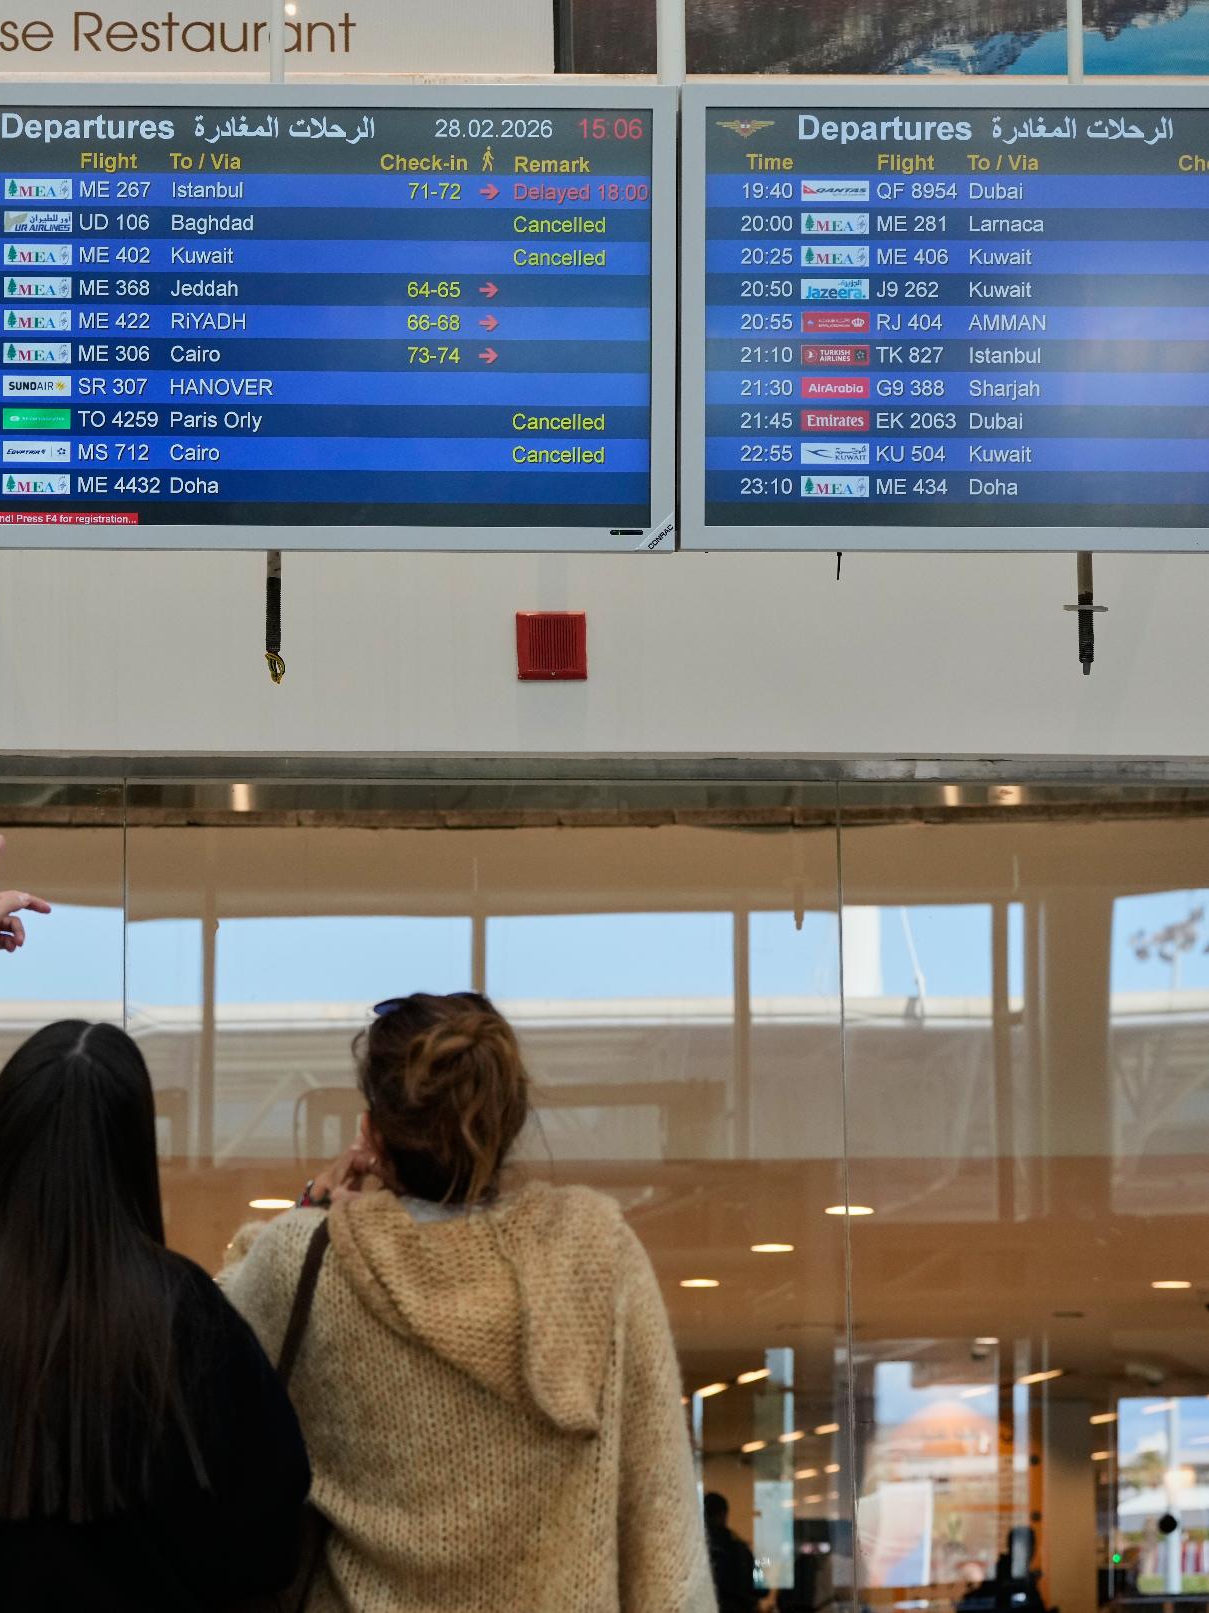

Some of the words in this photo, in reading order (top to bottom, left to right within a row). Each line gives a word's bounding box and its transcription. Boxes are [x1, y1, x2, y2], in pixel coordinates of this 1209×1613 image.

[74, 11, 357, 53] Restaurant
[1, 112, 175, 143] Departures
[194, 114, 279, 144] المغادرة
[288, 115, 375, 145] الرحلات
[435, 119, 553, 138] 28.02.2026
[579, 117, 643, 140] 15:06
[798, 114, 973, 144] Departures
[991, 115, 1077, 145] المغادرة
[1086, 116, 1174, 146] الرحلات
[80, 152, 138, 172] Flight
[170, 153, 193, 170] To
[198, 152, 205, 170] /
[210, 153, 241, 170] Via
[380, 153, 468, 171] Check-in
[514, 155, 590, 172] Remark
[746, 153, 794, 171] Time
[877, 154, 934, 174] Flight
[967, 154, 990, 171] To
[996, 154, 1003, 171] /
[1008, 154, 1039, 171] Via
[19, 184, 56, 198] MEA
[80, 181, 110, 198] ME
[117, 181, 151, 198] 267
[173, 182, 244, 199] Istanbul
[409, 182, 461, 199] 71-72
[514, 183, 590, 205] Delayed
[598, 184, 649, 201] 18:00
[742, 183, 793, 199] 19:40
[876, 183, 905, 200] QF
[911, 183, 958, 199] 8954
[969, 183, 1023, 200] Dubai
[29, 223, 71, 232] AIRLINES
[80, 214, 109, 231] UD
[117, 214, 150, 231] 106
[172, 215, 254, 235] Baghdad
[513, 216, 606, 233] Cancelled
[741, 216, 793, 232] 20:00
[816, 220, 855, 232] MEA
[877, 216, 908, 232] ME
[914, 216, 946, 232] 281
[969, 216, 1044, 233] Larnaca
[741, 281, 793, 298] 20:50
[877, 281, 898, 298] J9
[905, 281, 939, 298] 262
[969, 282, 1032, 298] Kuwait
[80, 313, 109, 329] ME
[115, 313, 150, 329] 422
[171, 313, 246, 330] RiYADH
[407, 314, 460, 331] 66-68
[741, 347, 793, 363] 21:10
[876, 347, 903, 364] TK
[909, 347, 944, 364] 827
[969, 347, 1041, 364] Istanbul
[8, 381, 54, 391] SUNDAIR
[79, 378, 107, 395] SR
[113, 378, 148, 395] 307
[171, 379, 274, 396] HANOVER
[741, 380, 793, 396] 21:30
[808, 383, 864, 393] AirArabia
[877, 380, 904, 397] G9
[911, 380, 945, 397] 388
[969, 380, 1040, 401] Sharjah
[78, 411, 106, 428] TO
[112, 411, 159, 428] 4259
[171, 411, 218, 428] Paris
[224, 412, 263, 433] Orly
[512, 413, 605, 431] Cancelled
[741, 412, 793, 429] 21:45
[807, 414, 865, 427] Emirates
[877, 413, 904, 429] EK
[910, 413, 957, 430] 2063
[970, 413, 1023, 430] Dubai
[741, 445, 793, 462] 22:55
[877, 446, 905, 463] KU
[912, 446, 946, 462] 504
[970, 446, 1032, 463] Kuwait
[78, 477, 107, 493] ME
[114, 477, 161, 494] 4432
[170, 477, 219, 494] Doha
[16, 514, 44, 523] Press
[45, 514, 57, 523] F4
[59, 514, 73, 523] for
[647, 524, 674, 550] CONRAC
